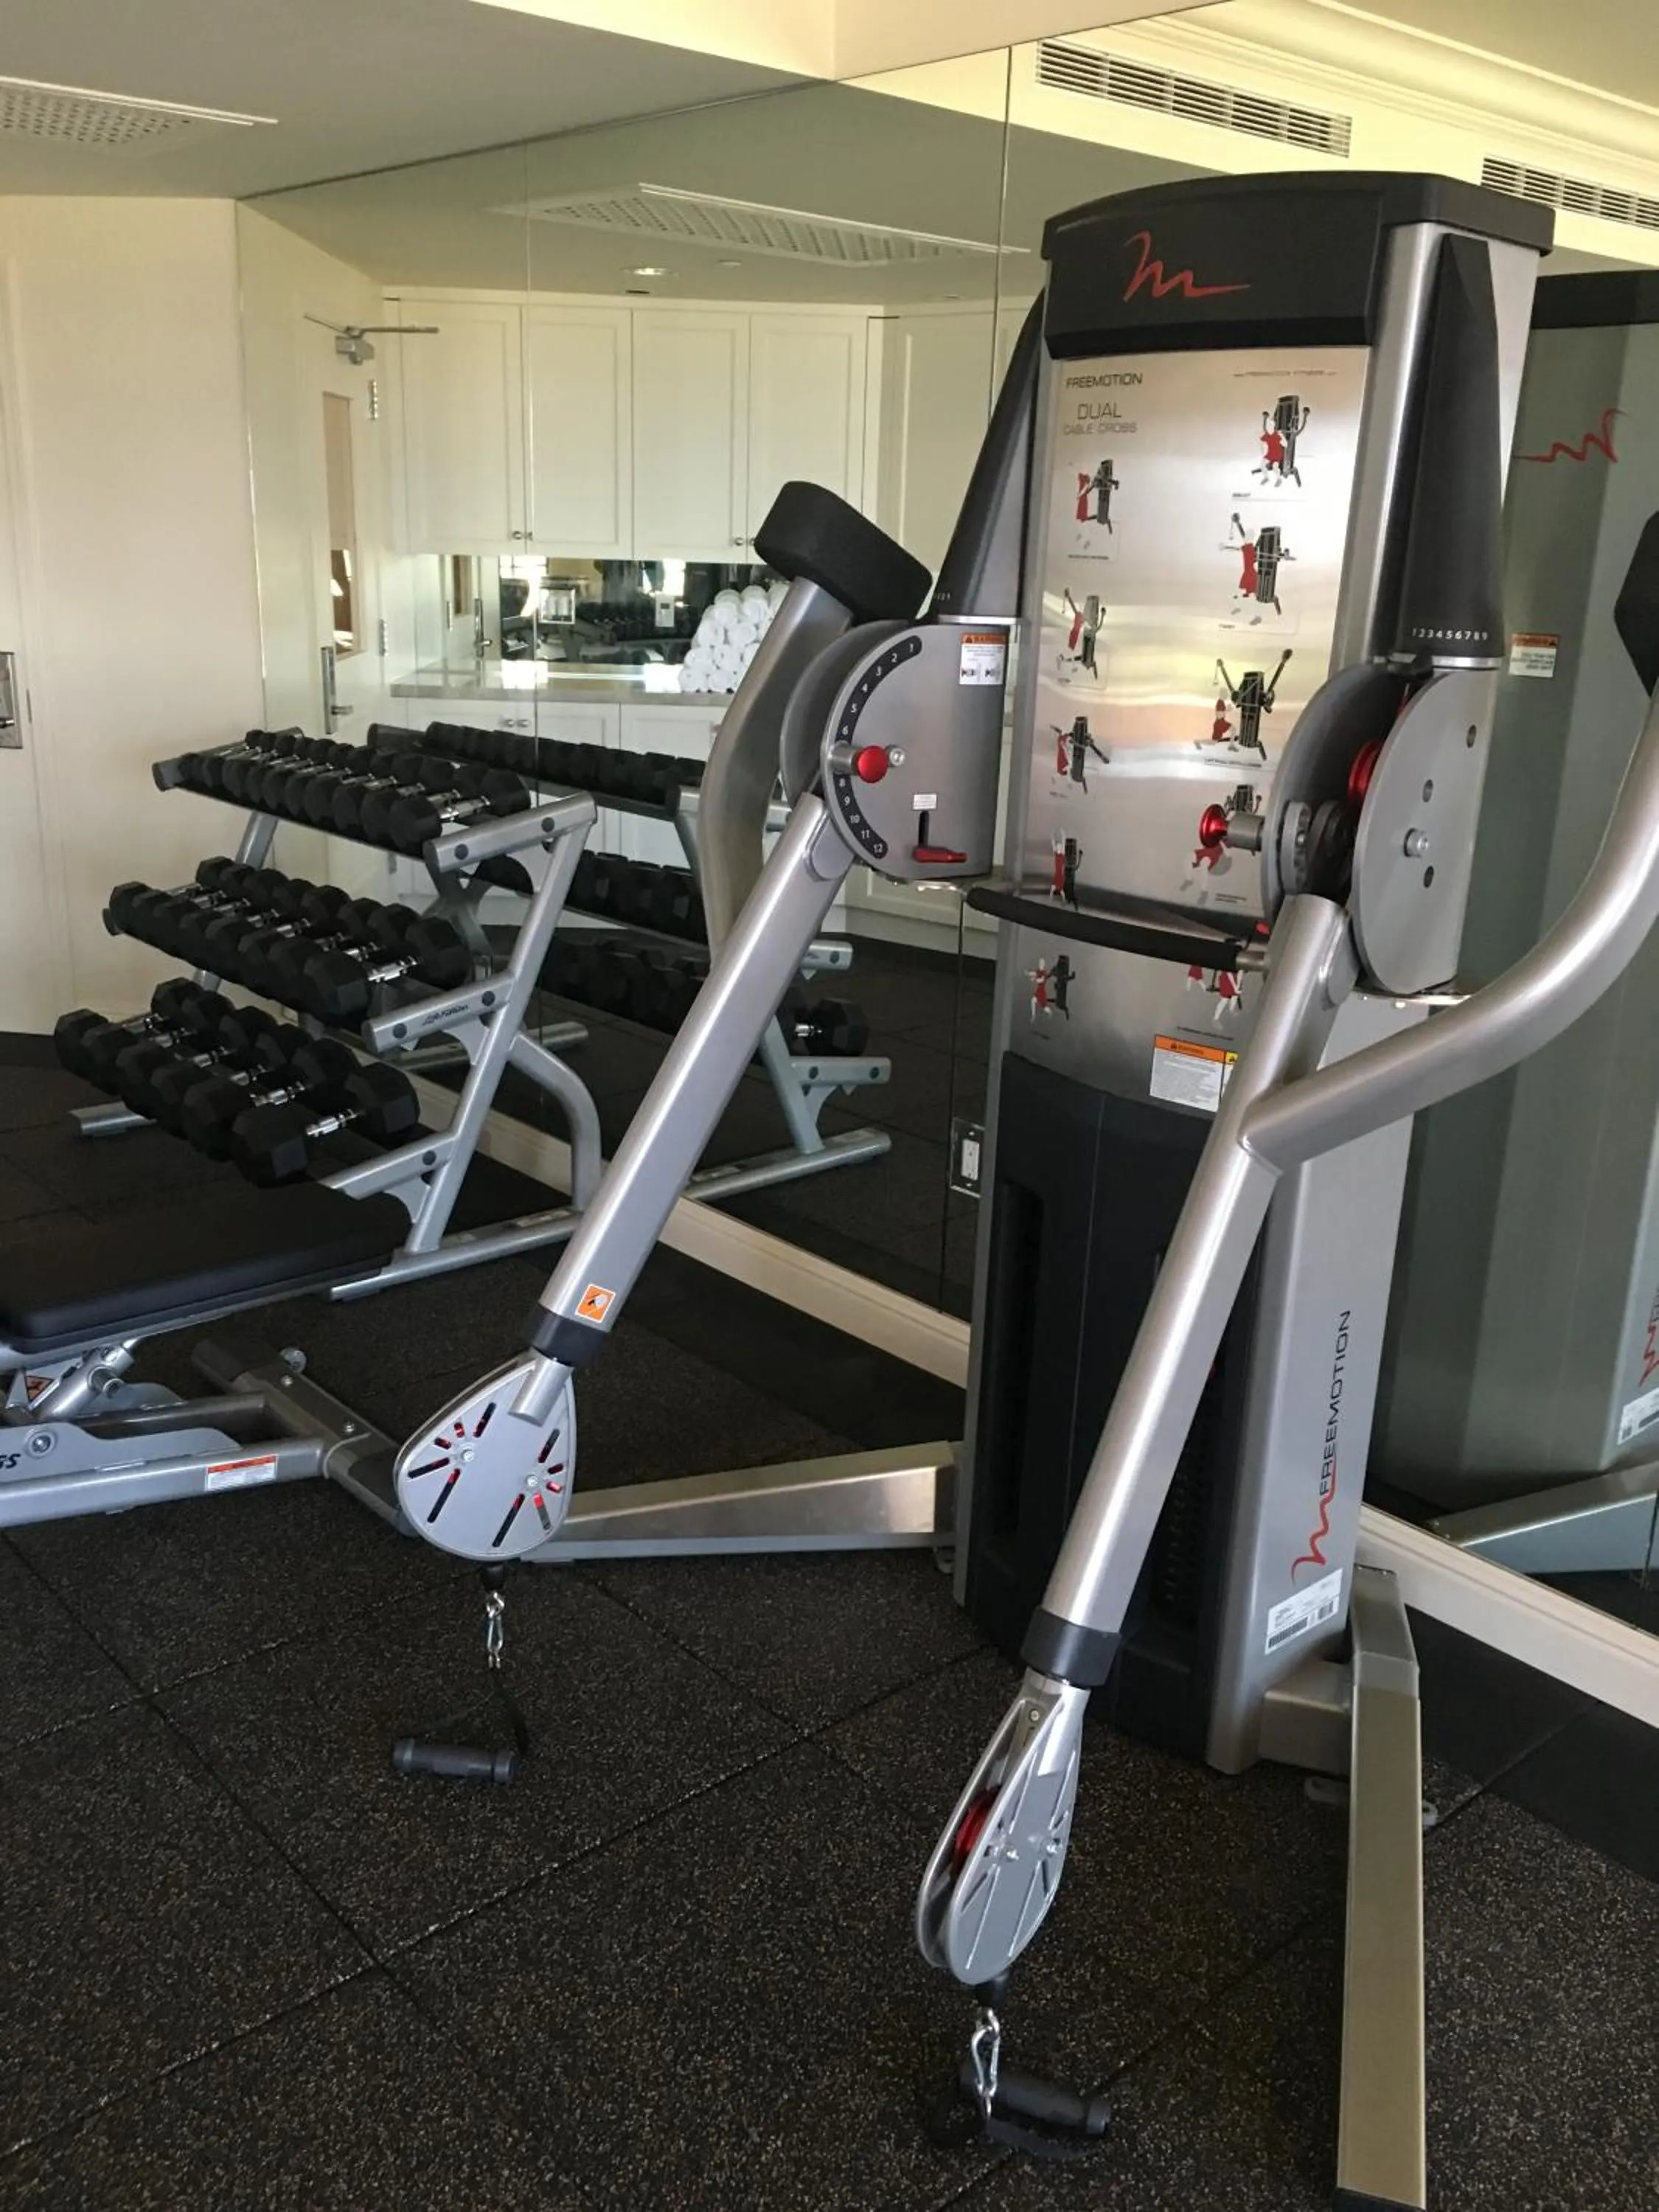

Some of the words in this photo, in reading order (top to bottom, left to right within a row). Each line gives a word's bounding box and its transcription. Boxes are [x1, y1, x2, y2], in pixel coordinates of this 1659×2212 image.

[1065, 372, 1143, 389] FREEMOTION
[1077, 402, 1122, 420] DUAL
[1419, 628, 1425, 638] 2
[1445, 630, 1453, 639] 5
[1455, 630, 1462, 640] 6
[1464, 630, 1472, 640] 7
[909, 643, 914, 653] 1
[891, 653, 897, 663] 2
[861, 684, 869, 692] 4
[850, 703, 858, 713] 5
[841, 725, 849, 735] 6
[844, 796, 851, 806] 9
[849, 814, 860, 824] 10
[861, 829, 870, 838] 11
[873, 843, 883, 853] 12
[1320, 1310, 1351, 1496] FREEMOTION
